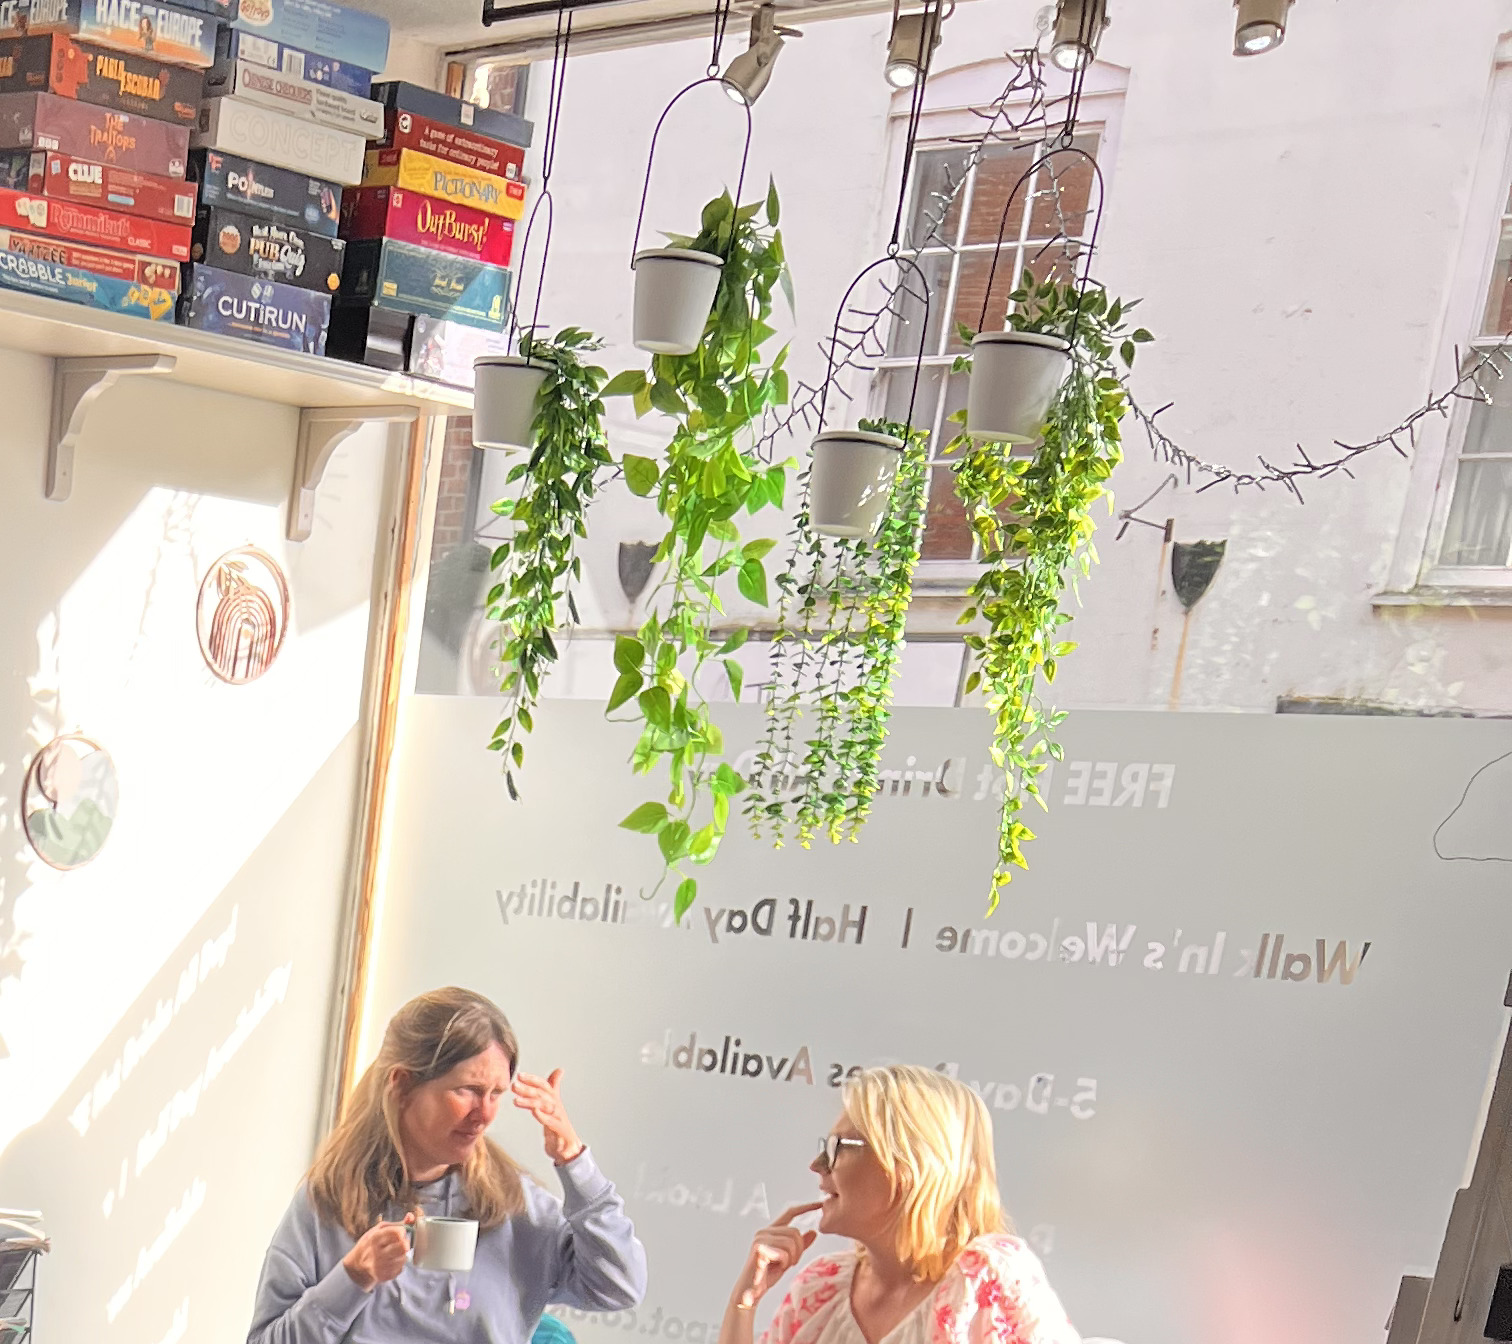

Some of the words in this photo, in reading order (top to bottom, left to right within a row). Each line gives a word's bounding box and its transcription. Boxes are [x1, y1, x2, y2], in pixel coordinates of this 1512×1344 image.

[156, 8, 204, 47] EUROPE
[231, 111, 358, 172] CONCEPT
[68, 162, 103, 184] CLUE
[431, 169, 505, 207] PICTIONARY
[249, 237, 281, 261] PUB
